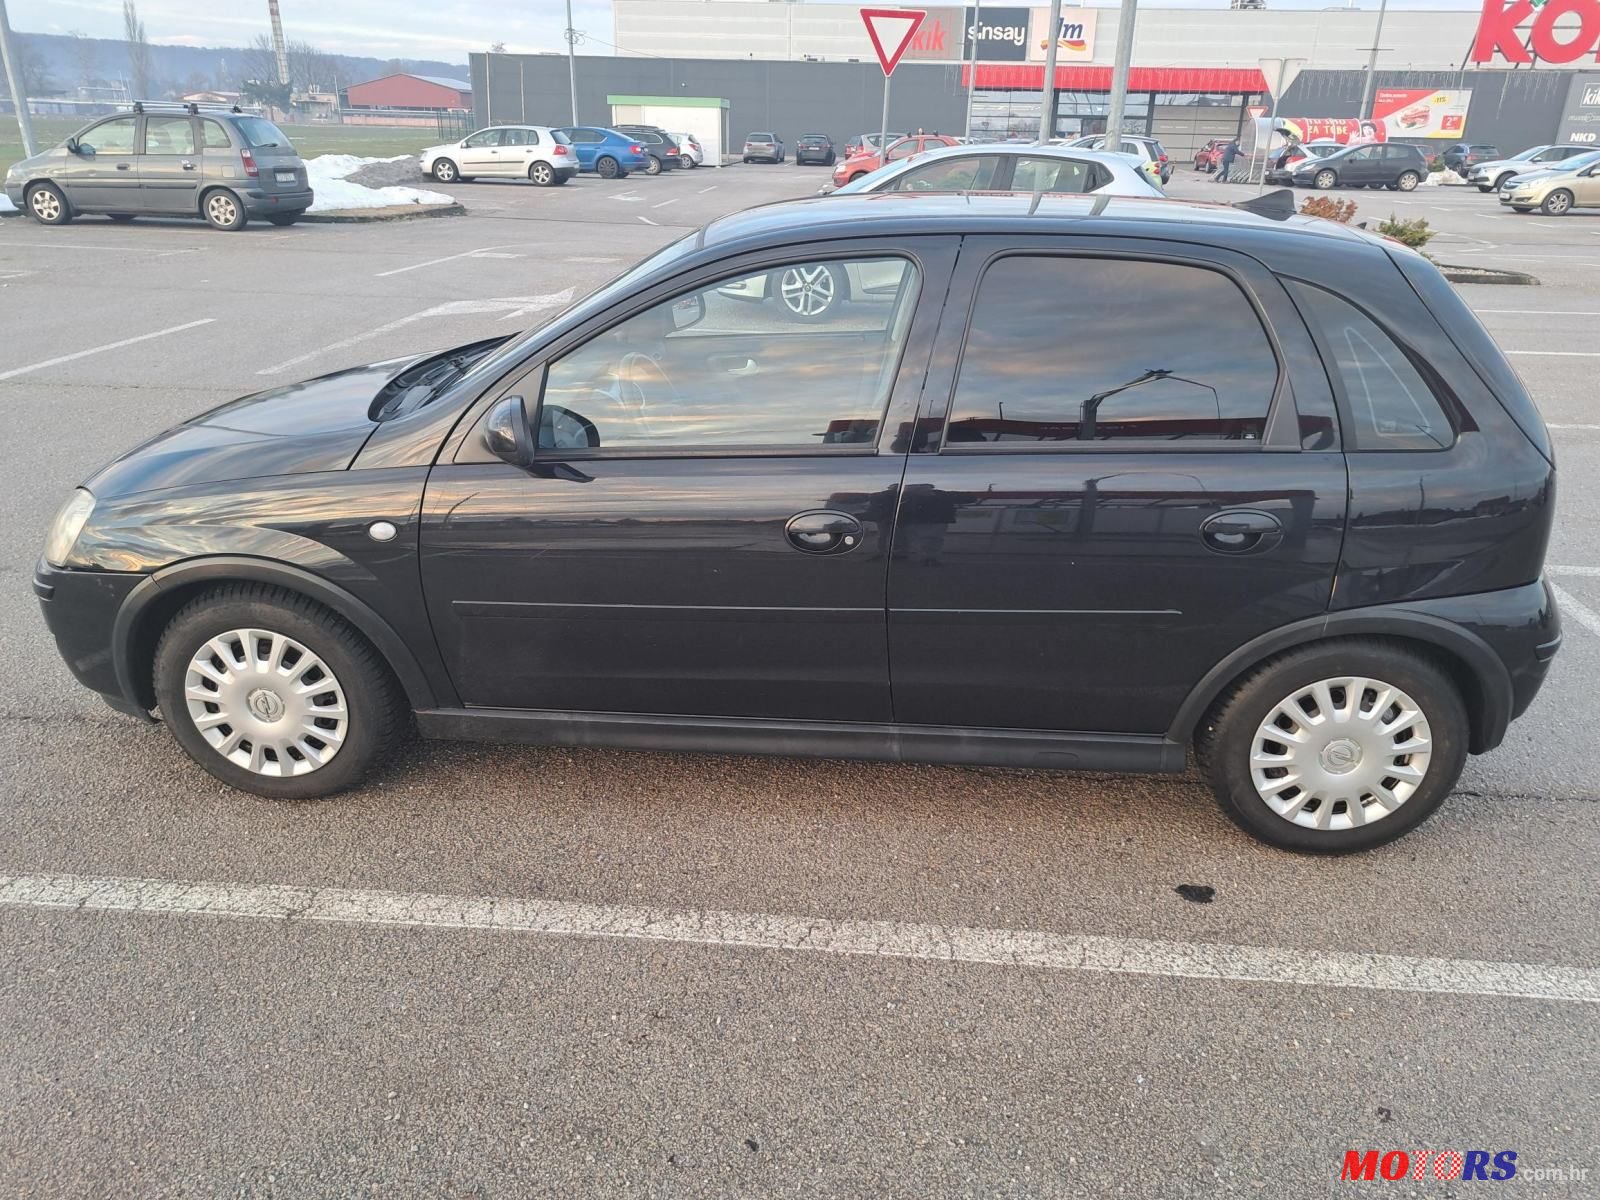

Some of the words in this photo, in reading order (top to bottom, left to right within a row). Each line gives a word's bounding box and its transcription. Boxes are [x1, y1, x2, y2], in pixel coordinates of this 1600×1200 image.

[967, 21, 1025, 46] sinsay
[1470, 0, 1600, 64] KO
[1570, 133, 1596, 142] NKD
